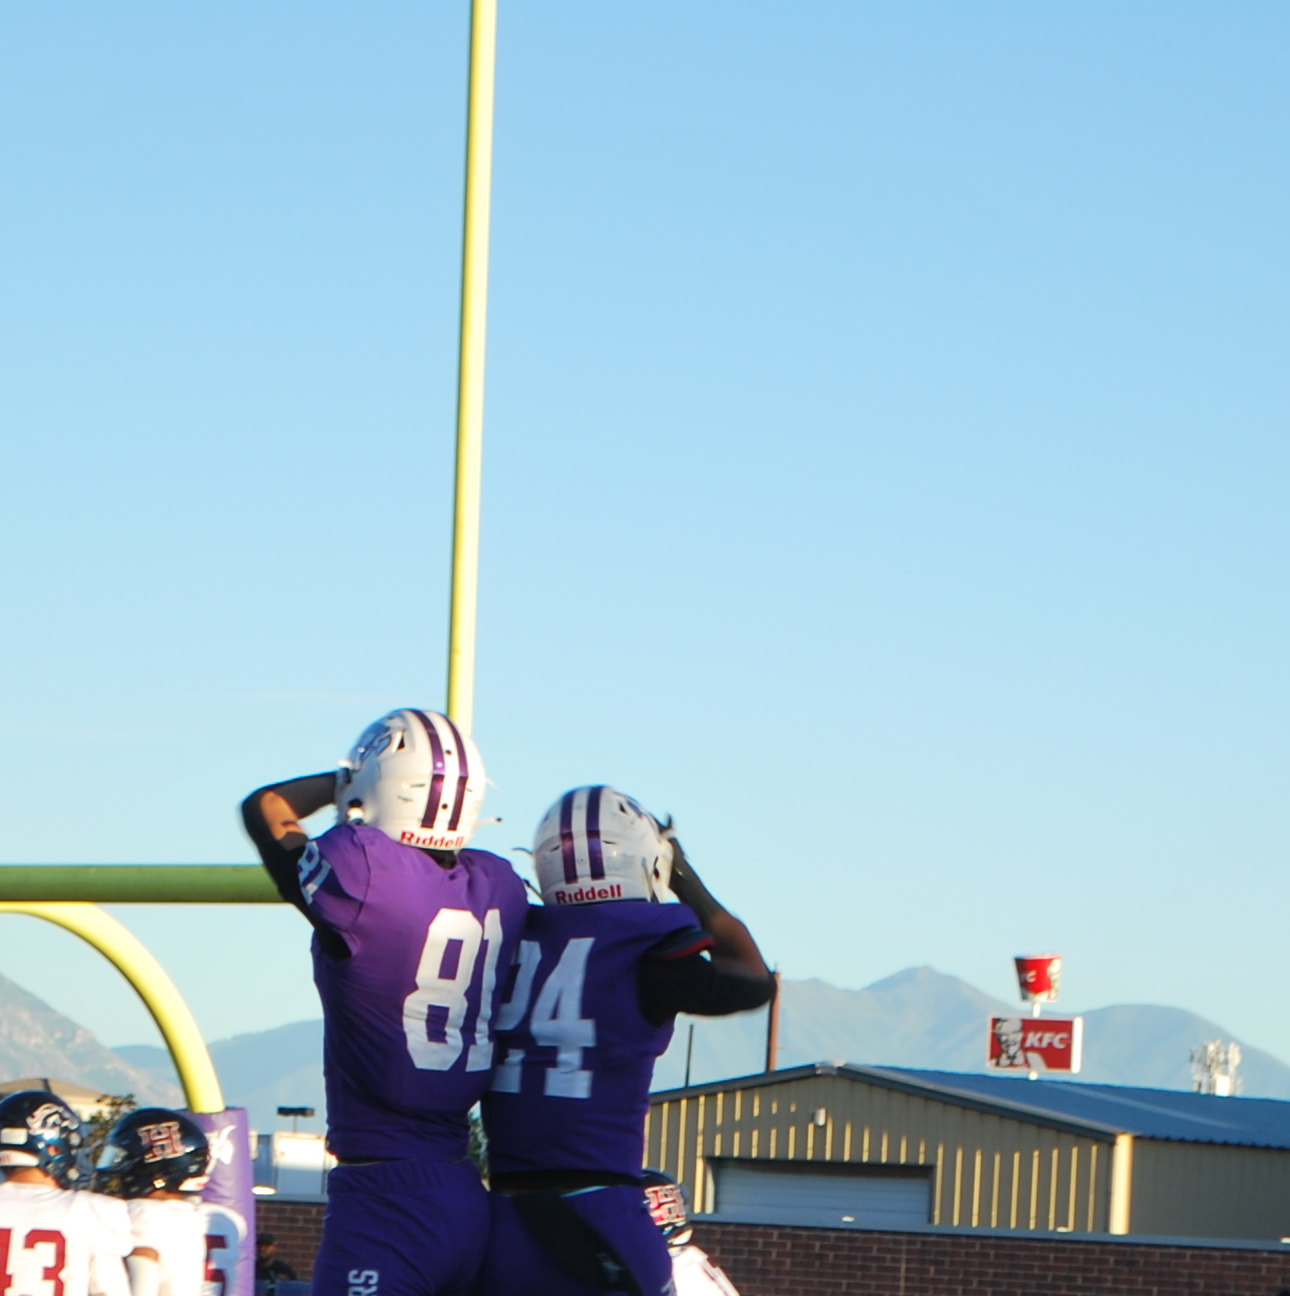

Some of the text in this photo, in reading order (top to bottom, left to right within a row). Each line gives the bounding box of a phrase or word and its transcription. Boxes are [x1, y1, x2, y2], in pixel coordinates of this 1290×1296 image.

[399, 830, 464, 849] Riddell
[555, 885, 621, 904] Riddell
[403, 907, 503, 1072] 81
[1024, 1031, 1068, 1049] KFC
[138, 1121, 184, 1163] H
